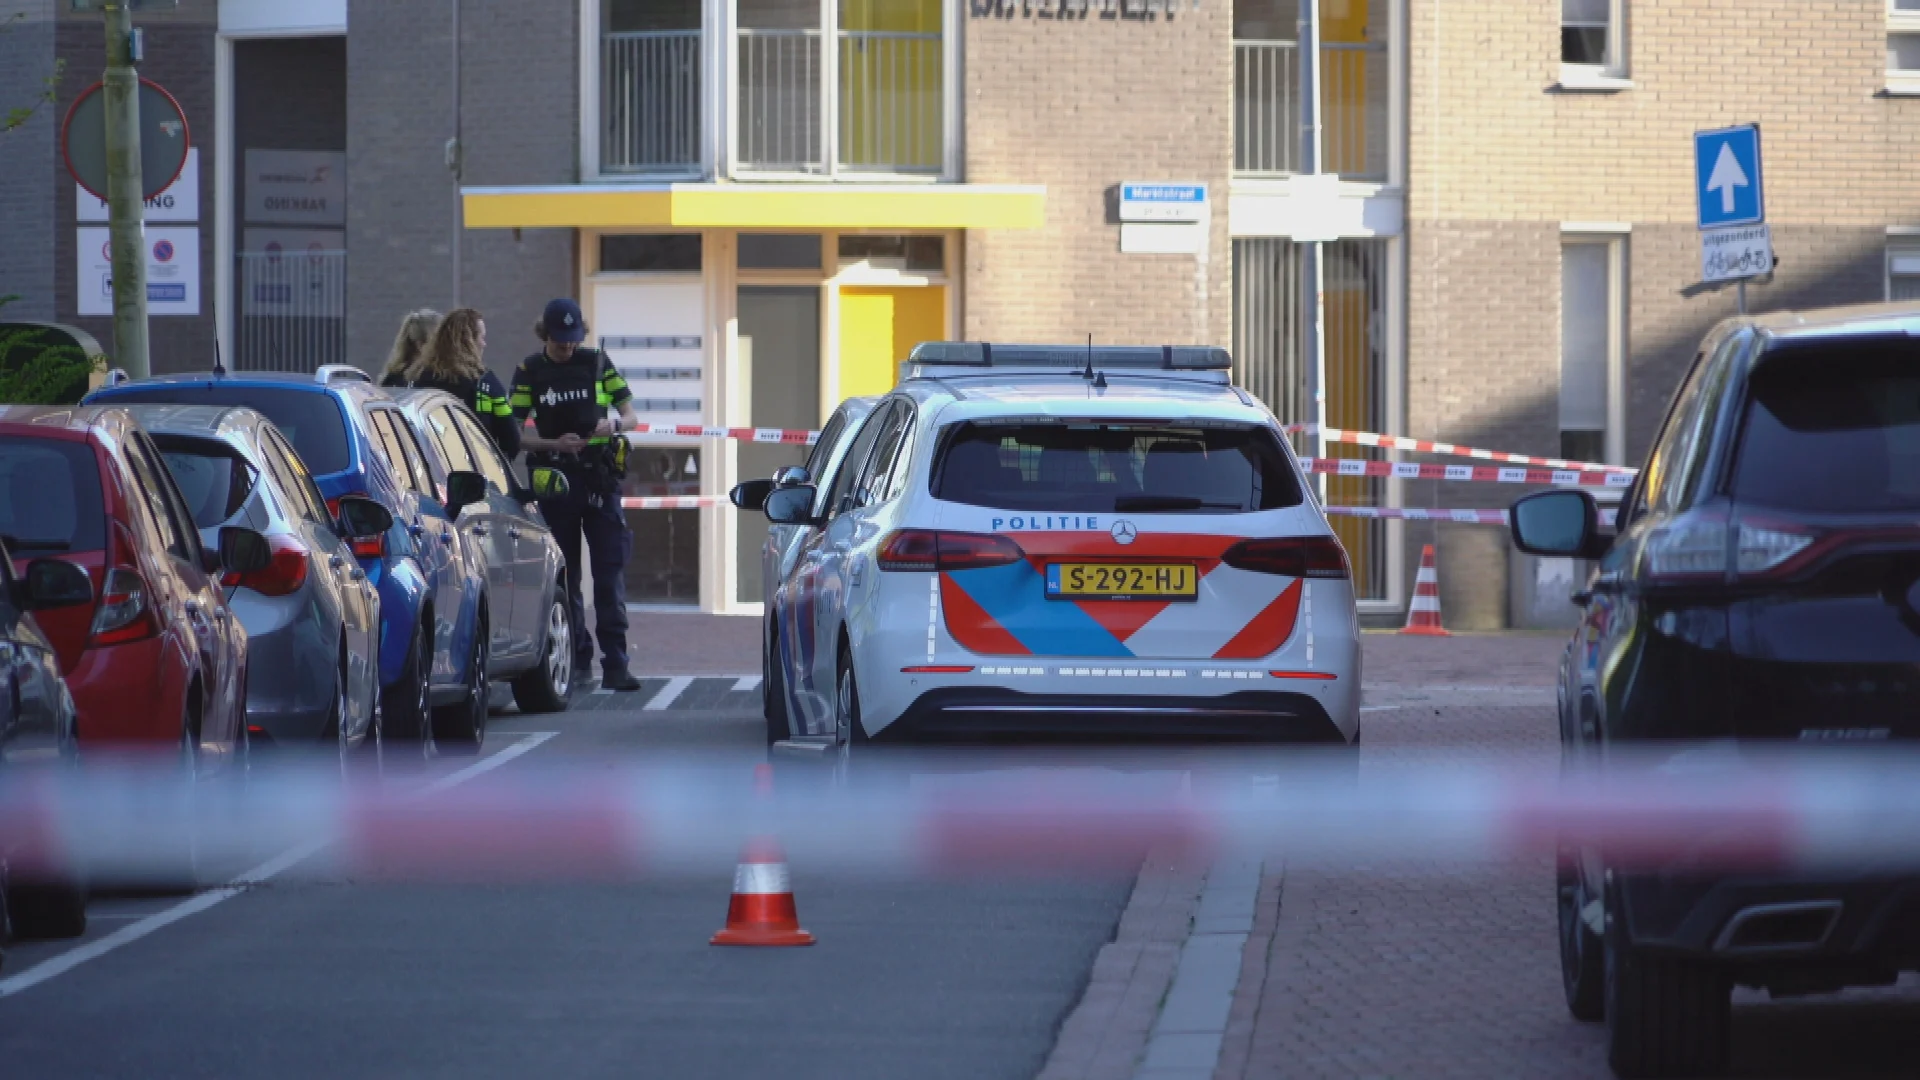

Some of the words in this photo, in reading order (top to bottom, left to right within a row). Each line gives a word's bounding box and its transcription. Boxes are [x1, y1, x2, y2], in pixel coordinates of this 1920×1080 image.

[1132, 187, 1194, 199] Marktstraat
[1703, 227, 1765, 247] uitgezonderd
[761, 432, 780, 440] NIET
[1398, 466, 1418, 474] NIET
[1504, 471, 1524, 479] NIET
[991, 516, 1098, 531] POLITIE
[1048, 581, 1059, 589] NL
[1070, 567, 1185, 591] S-292-HJ
